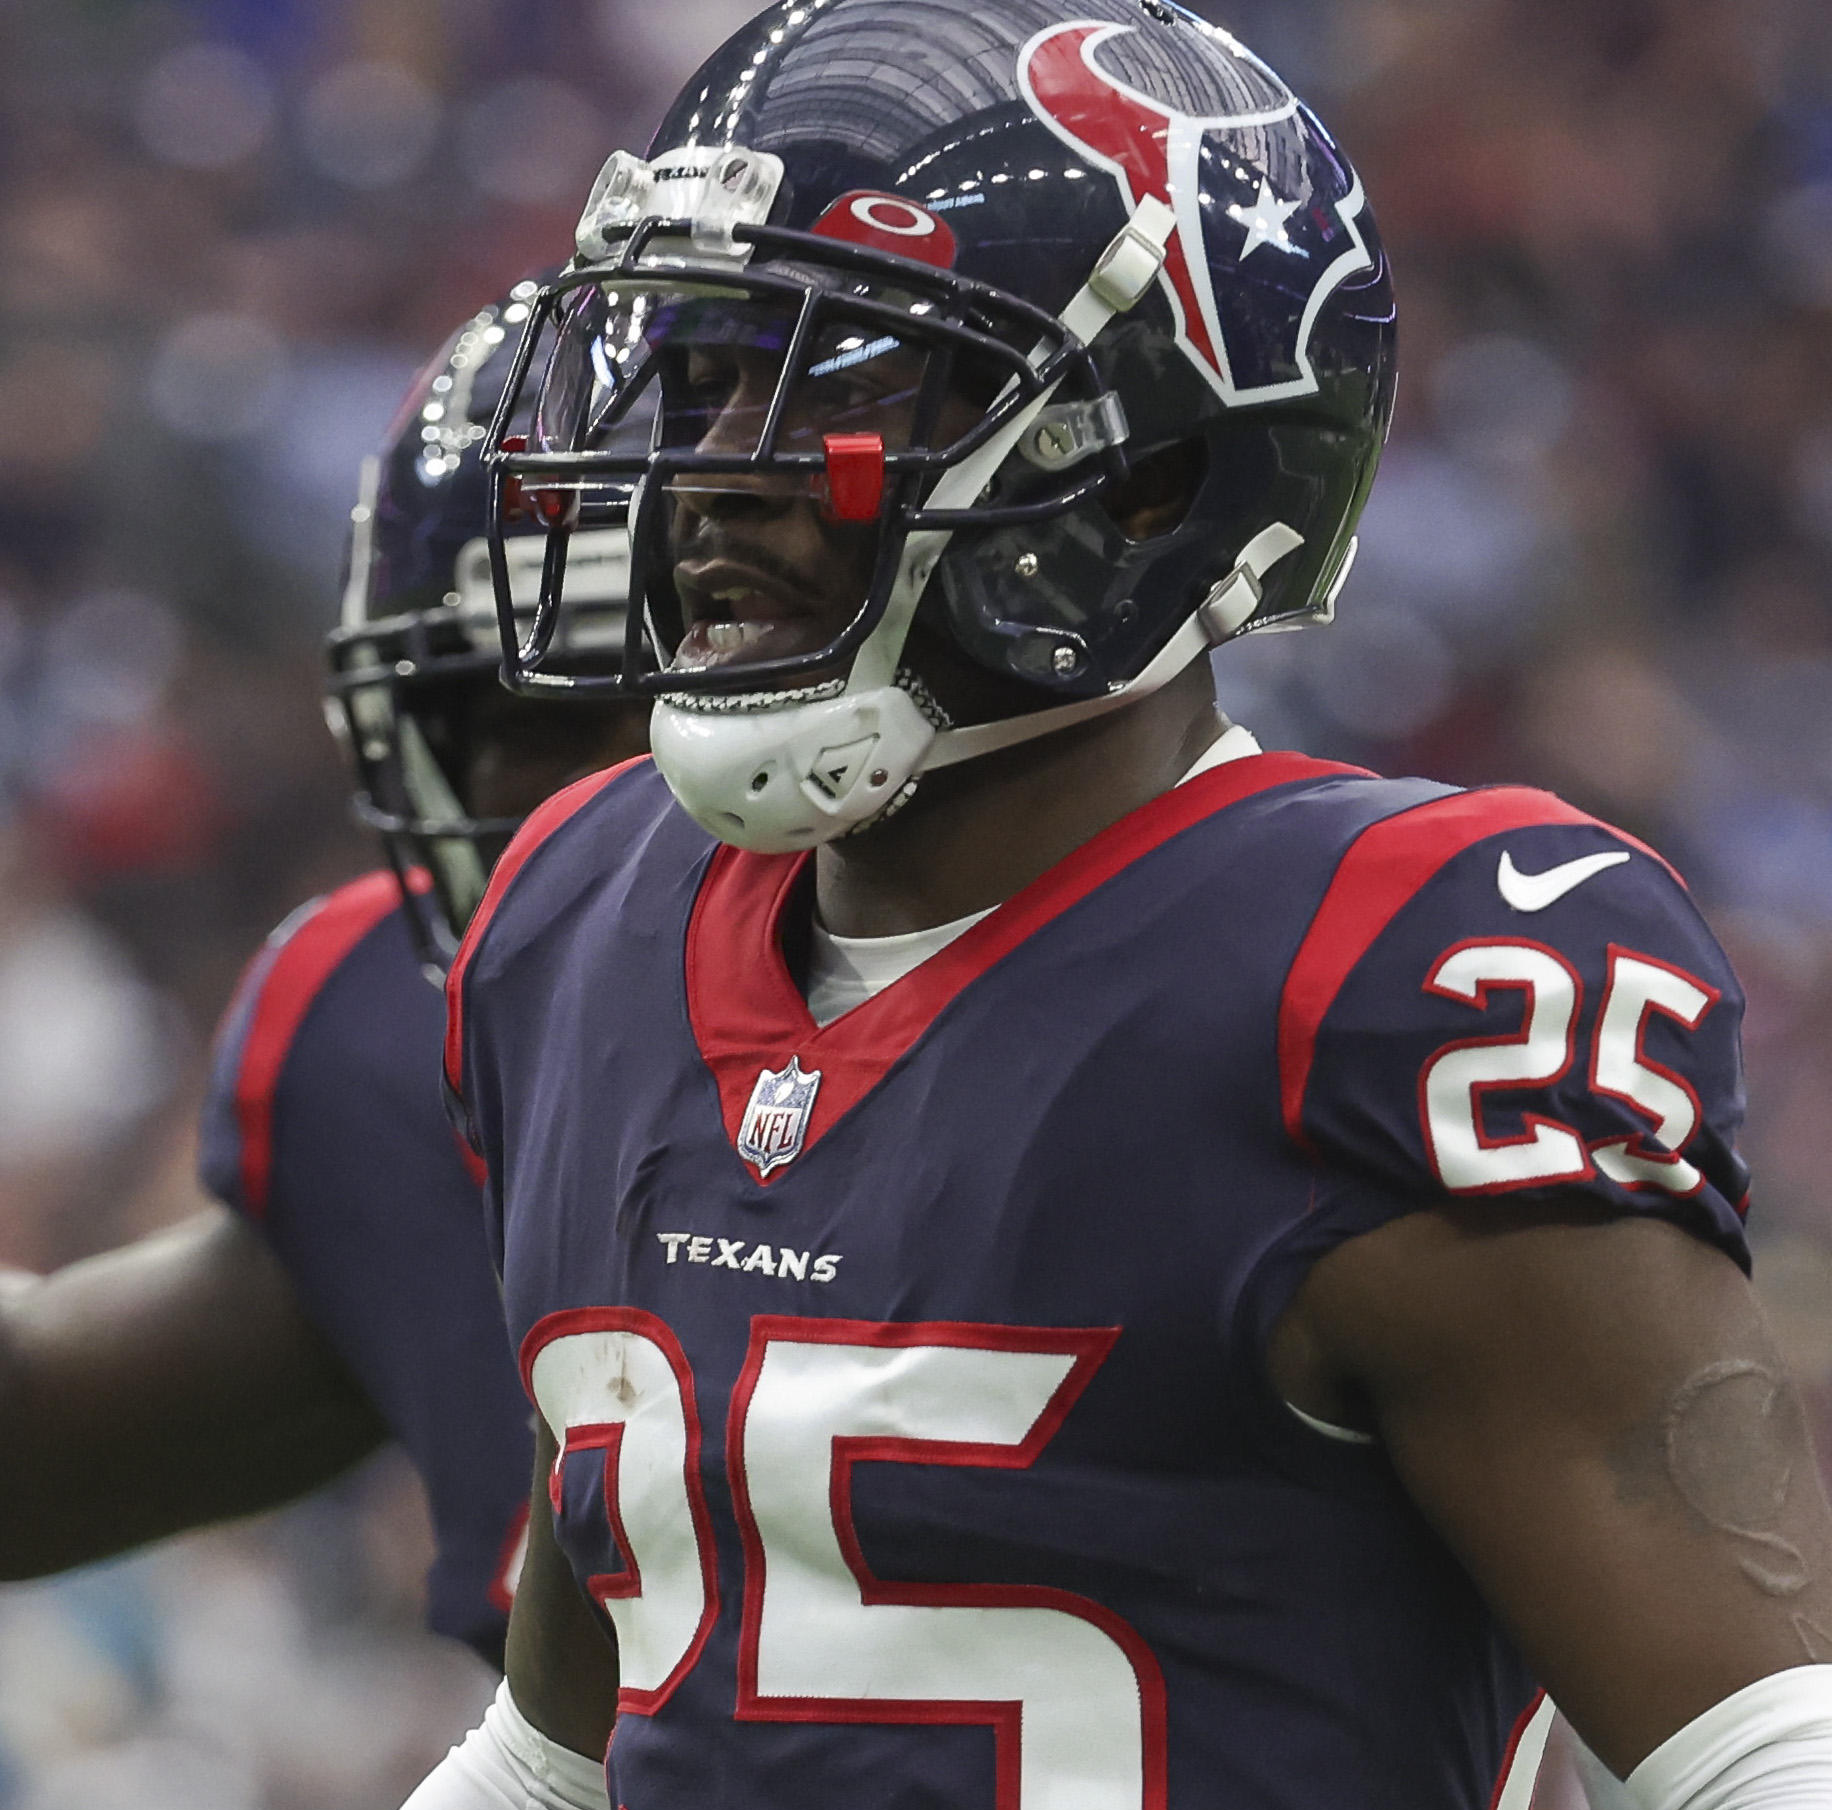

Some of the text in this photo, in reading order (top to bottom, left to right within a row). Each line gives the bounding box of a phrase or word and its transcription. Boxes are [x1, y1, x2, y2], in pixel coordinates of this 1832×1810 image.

[1417, 936, 1721, 1197] 25
[750, 1111, 794, 1151] NFL
[656, 1232, 844, 1283] TEXANS
